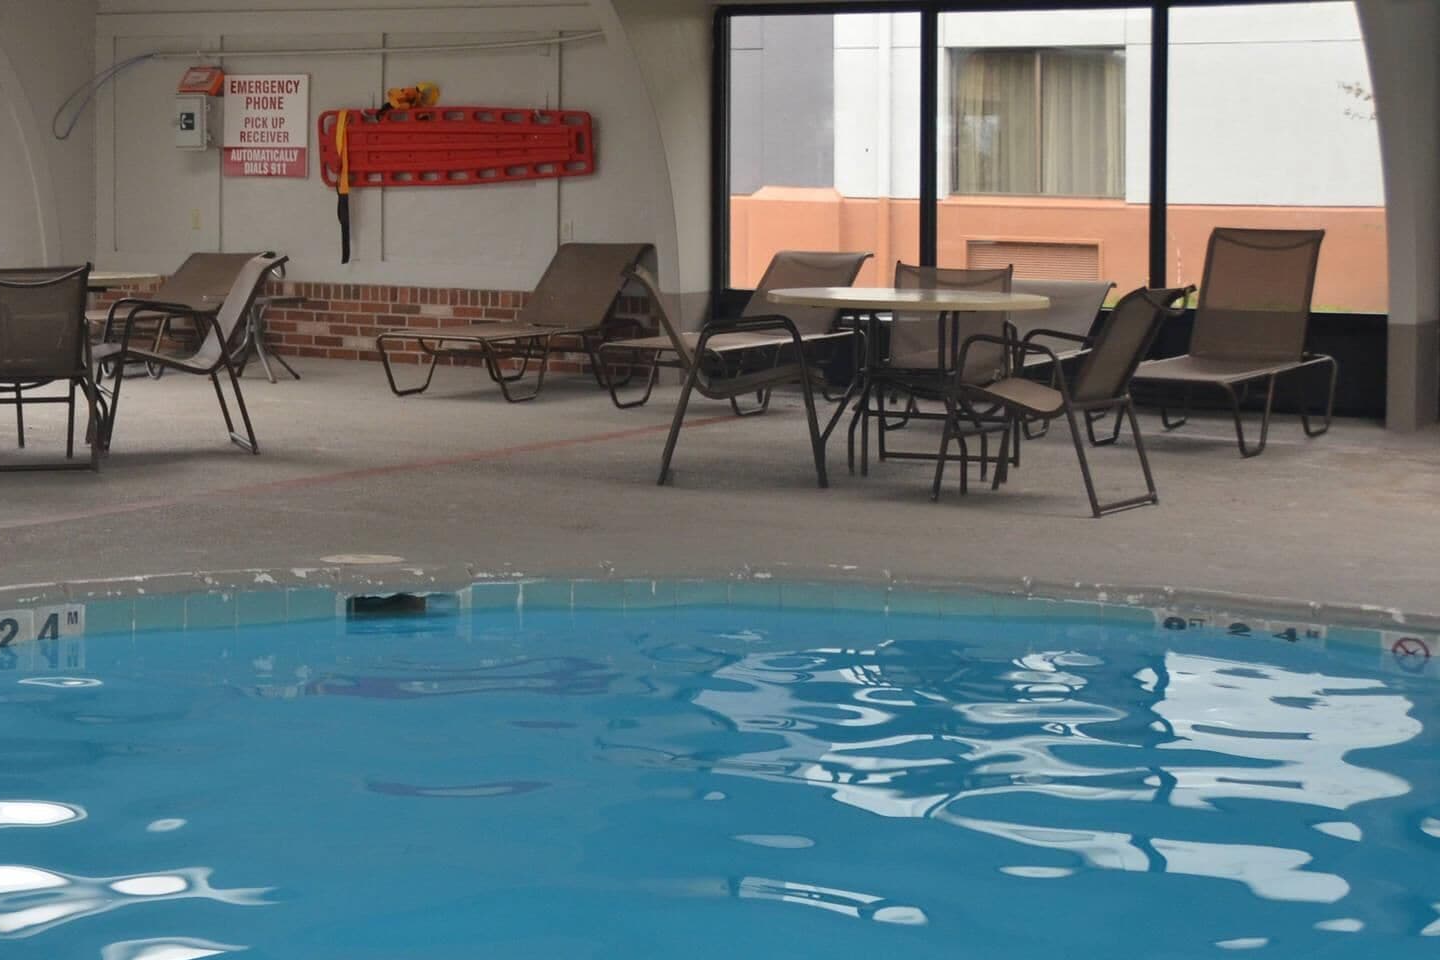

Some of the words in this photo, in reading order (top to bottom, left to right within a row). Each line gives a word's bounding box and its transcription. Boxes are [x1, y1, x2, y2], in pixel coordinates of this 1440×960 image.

[230, 79, 301, 95] EMERGENCY
[245, 96, 285, 111] PHONE
[244, 116, 269, 129] PICK
[271, 116, 286, 130] UP
[239, 131, 290, 143] RECEIVER
[230, 149, 299, 162] AUTOMATICALLY
[244, 162, 269, 175] DIALS
[270, 162, 287, 175] 911
